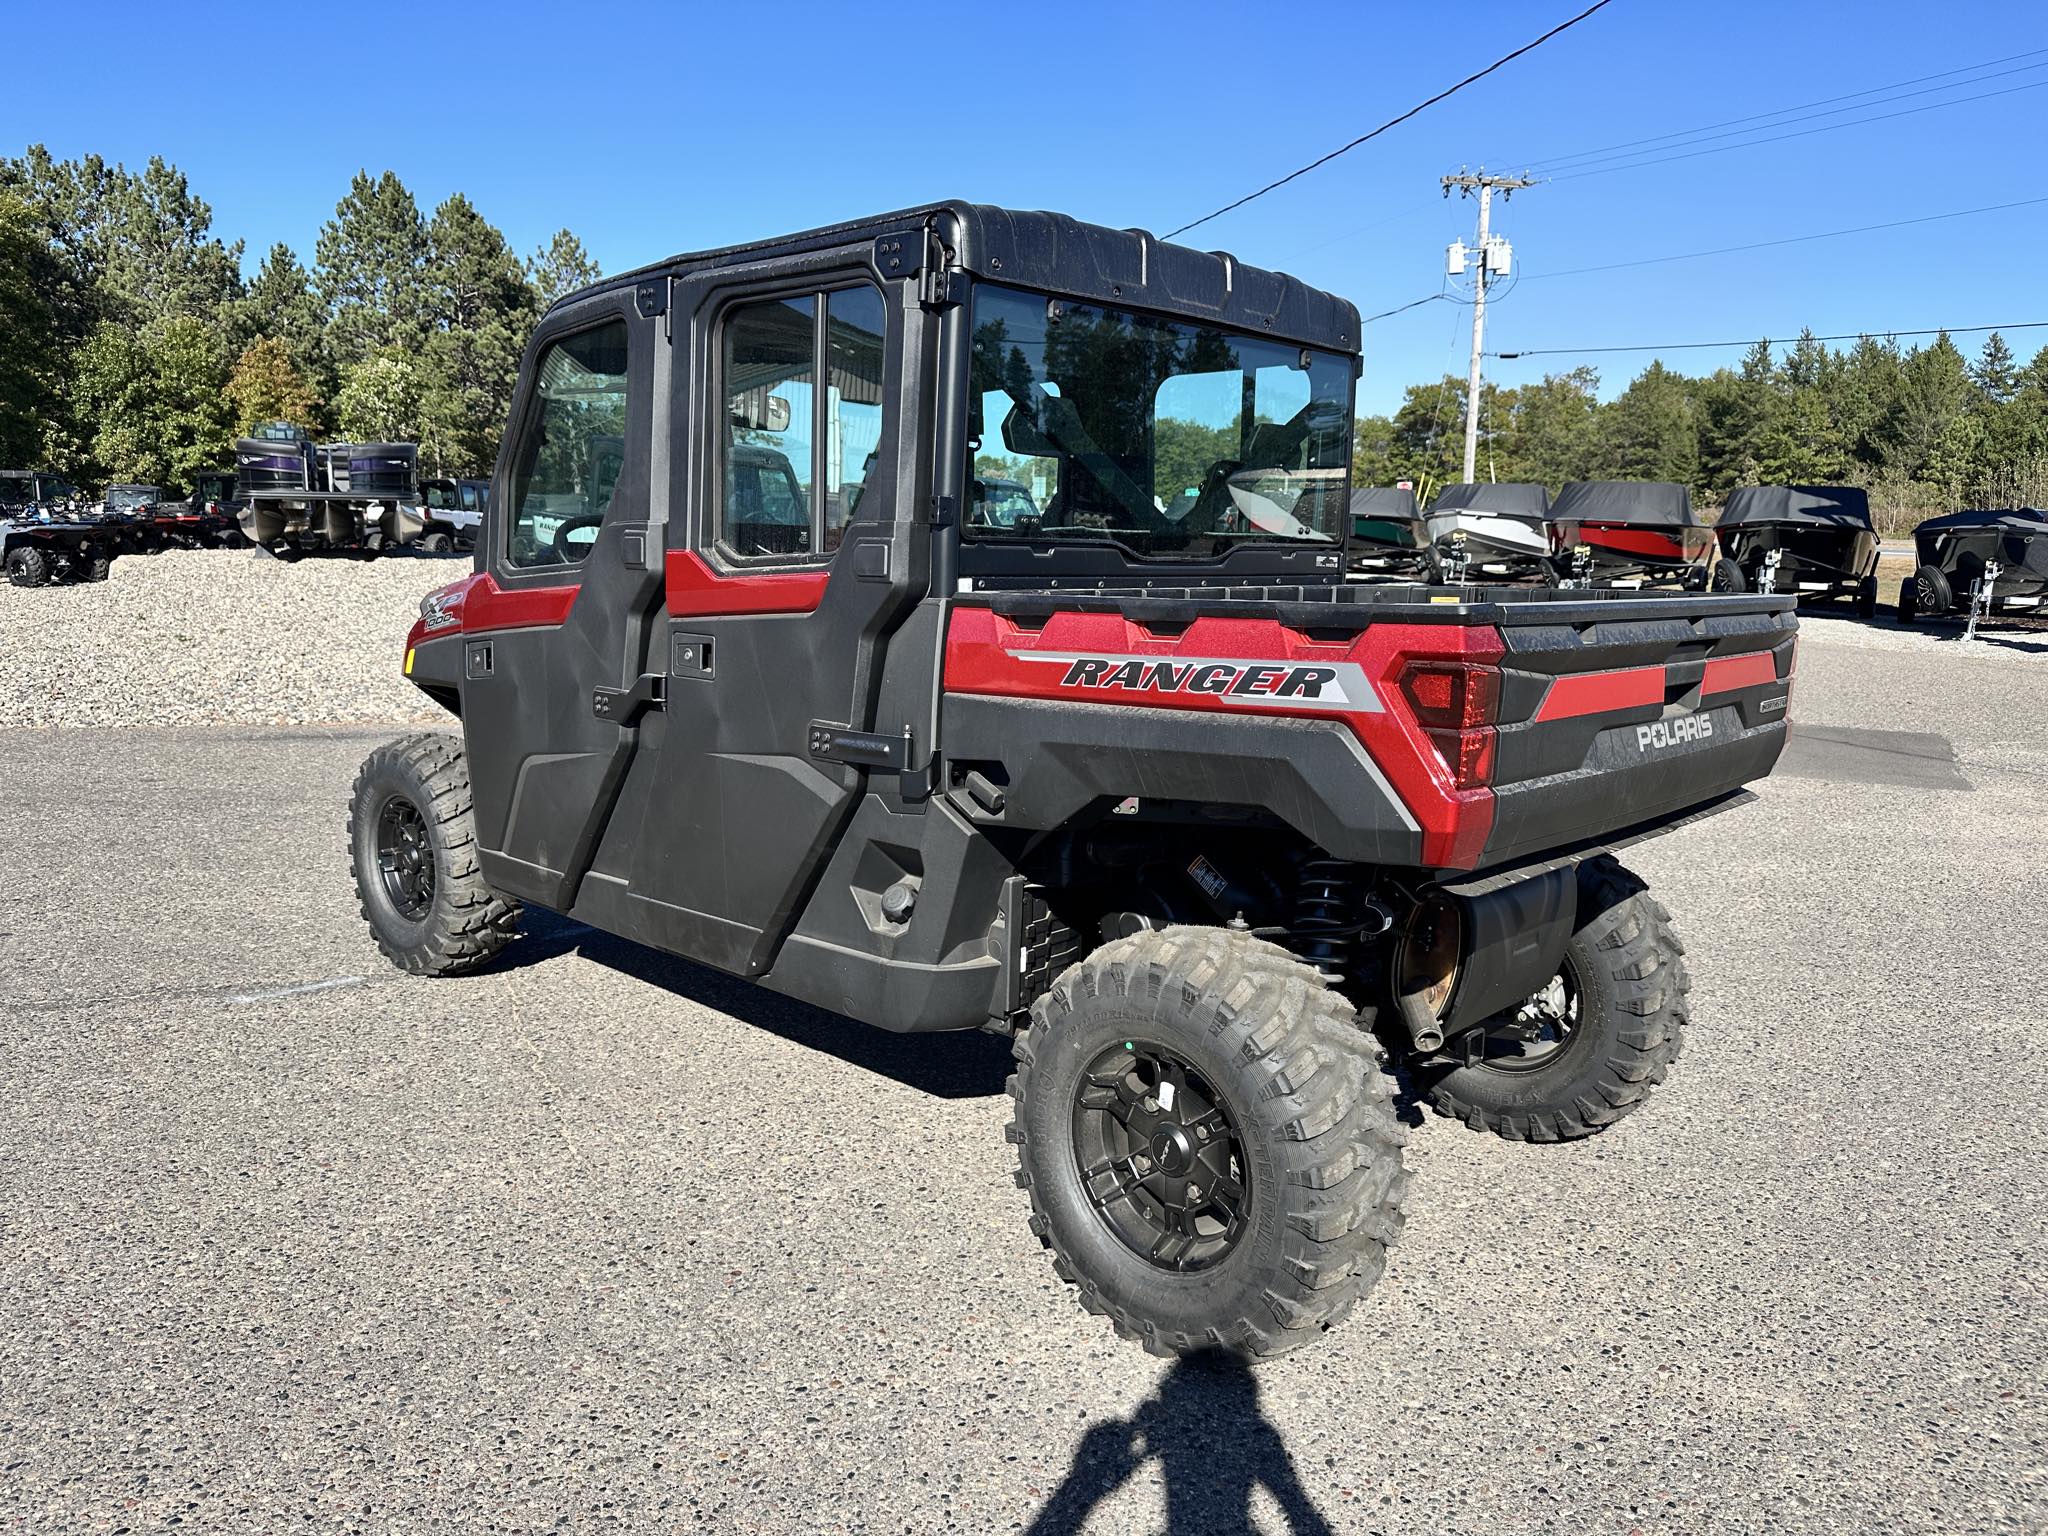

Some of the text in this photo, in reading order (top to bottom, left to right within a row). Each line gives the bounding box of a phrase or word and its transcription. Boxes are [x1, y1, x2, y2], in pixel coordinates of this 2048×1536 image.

[420, 592, 464, 619] XP
[424, 612, 454, 630] 1000
[1060, 658, 1337, 698] RANGER
[1636, 713, 1713, 752] POLARIS
